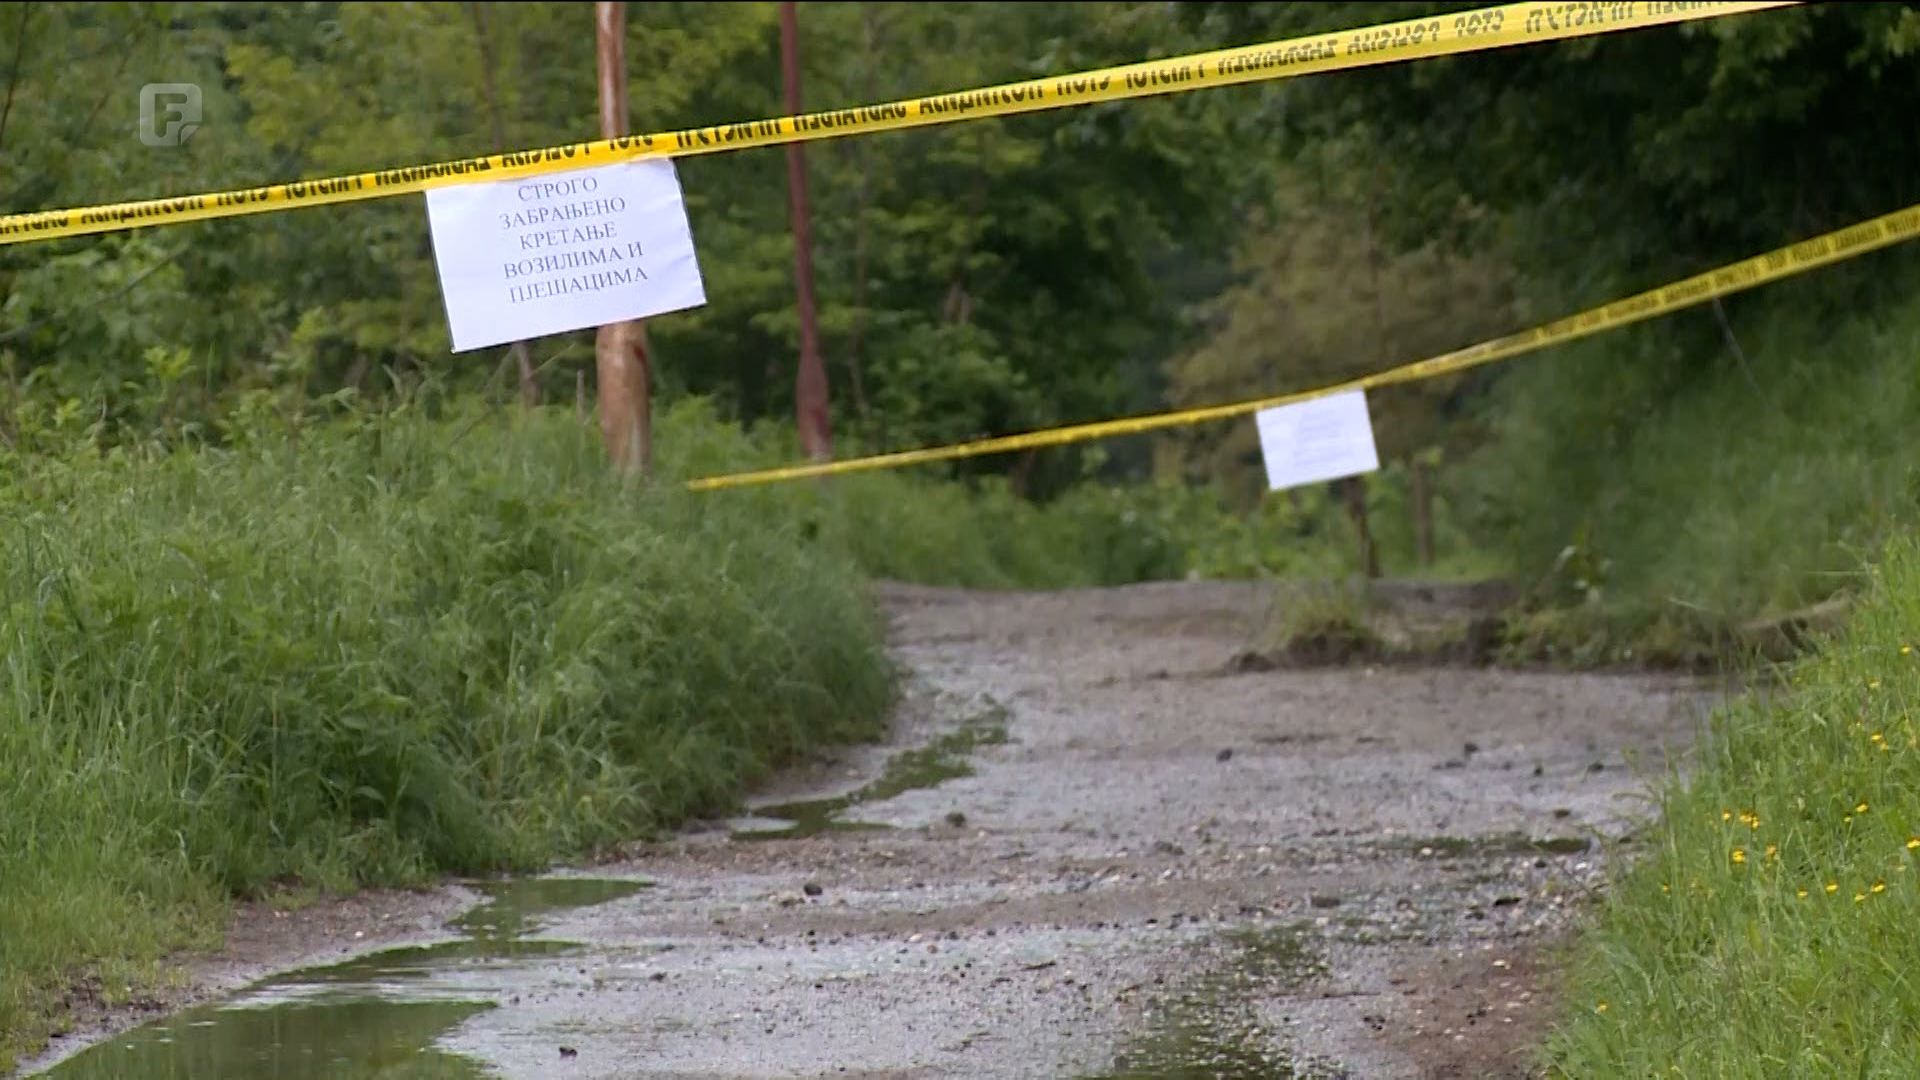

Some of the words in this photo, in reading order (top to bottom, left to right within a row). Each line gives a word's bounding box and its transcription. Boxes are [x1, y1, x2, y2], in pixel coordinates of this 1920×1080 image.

[517, 177, 598, 202] СТРОГО
[499, 197, 626, 230] ЗАБРАЊЕНО
[519, 221, 618, 250] КРЕТАЊЕ
[503, 246, 624, 279] ВОЗИЛИМА
[628, 241, 644, 259] И
[509, 266, 649, 303] ПЈЕШАЦИМА
